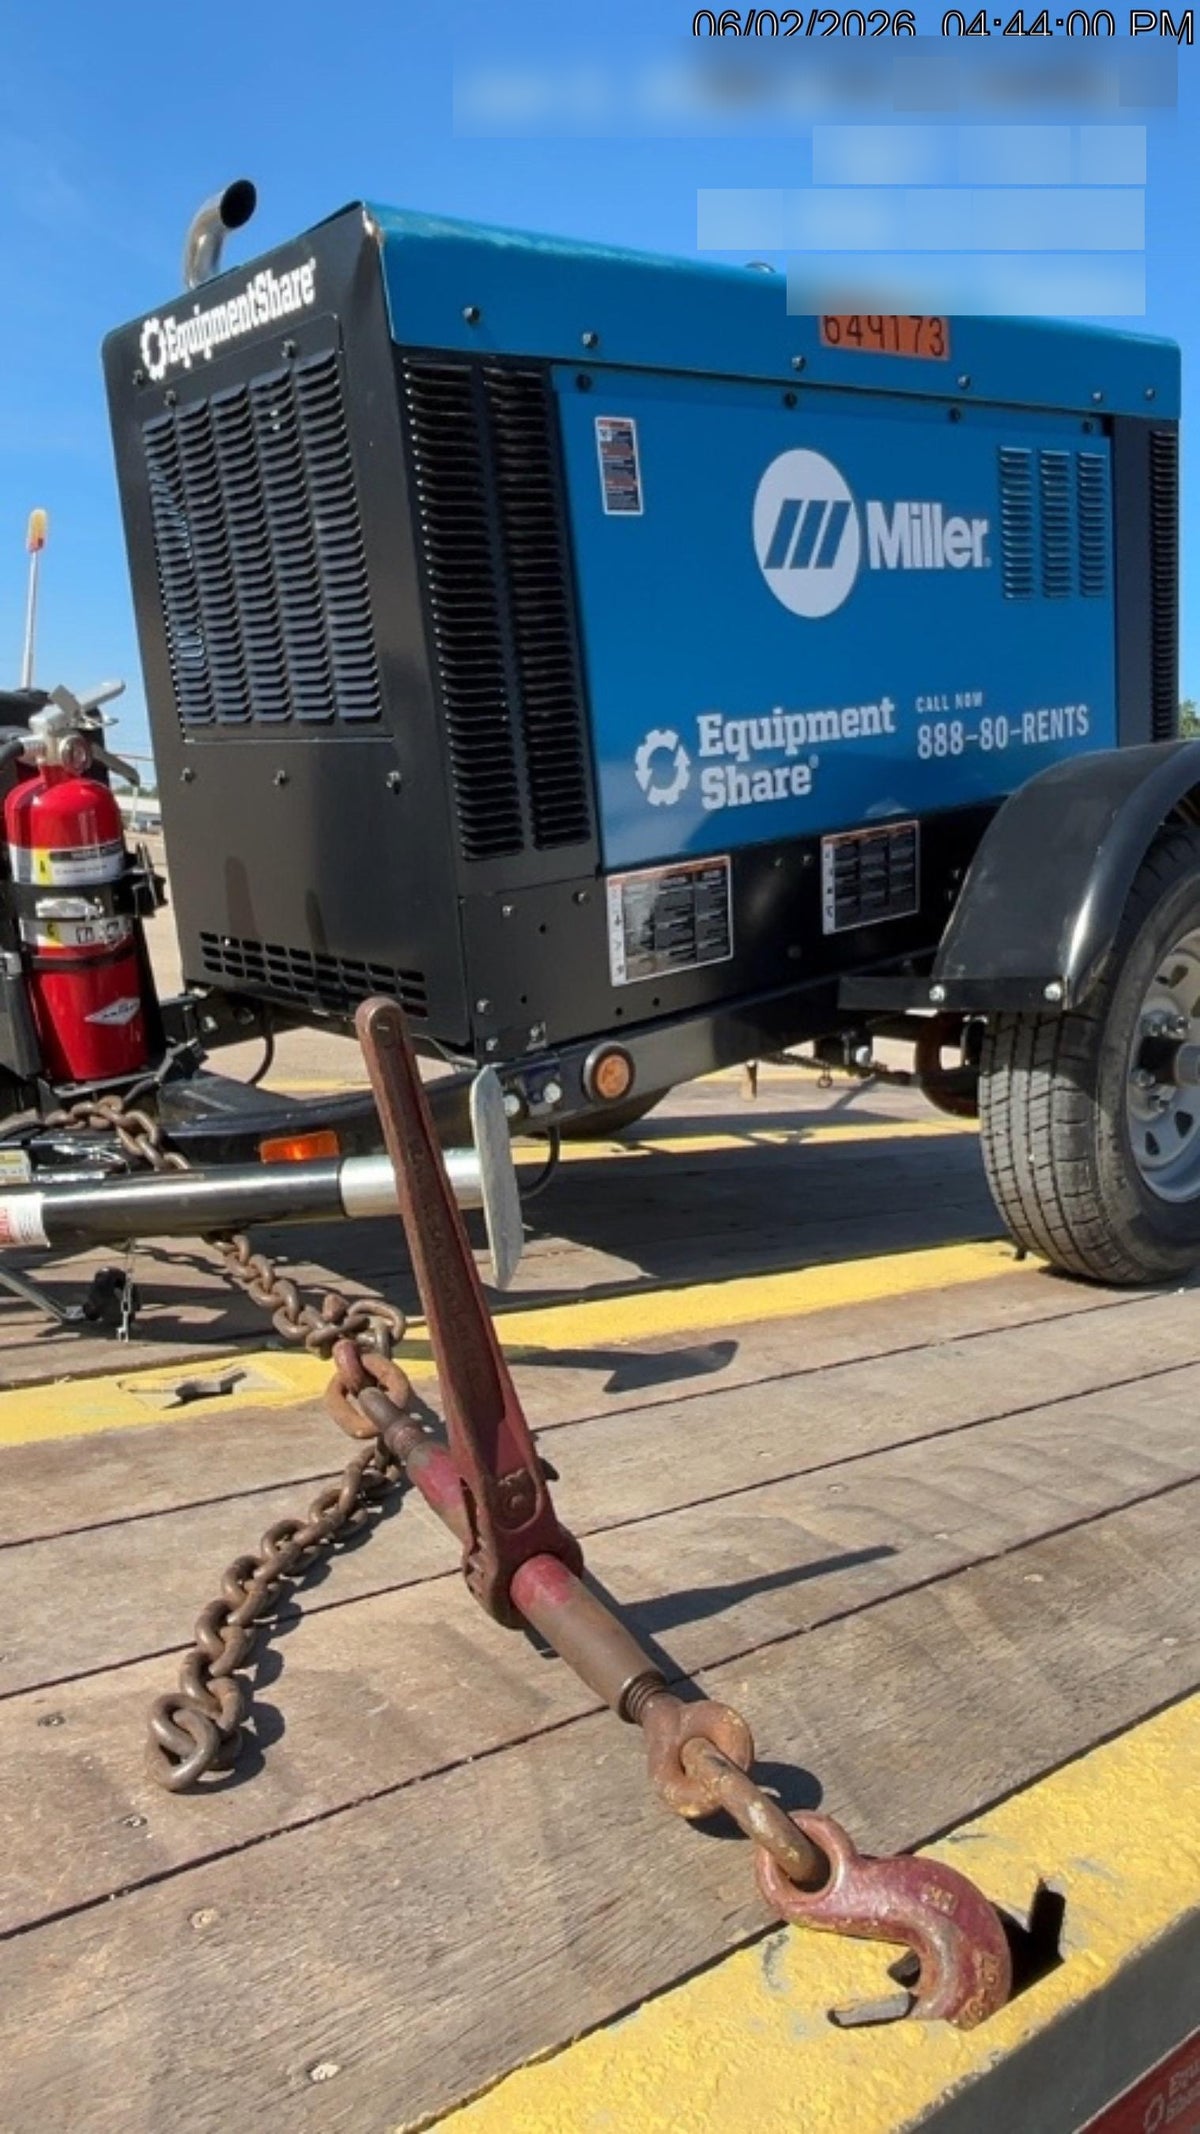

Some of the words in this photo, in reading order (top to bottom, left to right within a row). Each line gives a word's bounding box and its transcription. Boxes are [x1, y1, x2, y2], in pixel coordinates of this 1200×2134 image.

[866, 501, 989, 570] Miller
[697, 697, 895, 762] Equipment
[915, 695, 949, 713] CALL
[955, 692, 983, 710] NOW
[917, 704, 1089, 760] 888-80-RENTS
[700, 764, 813, 810] Share
